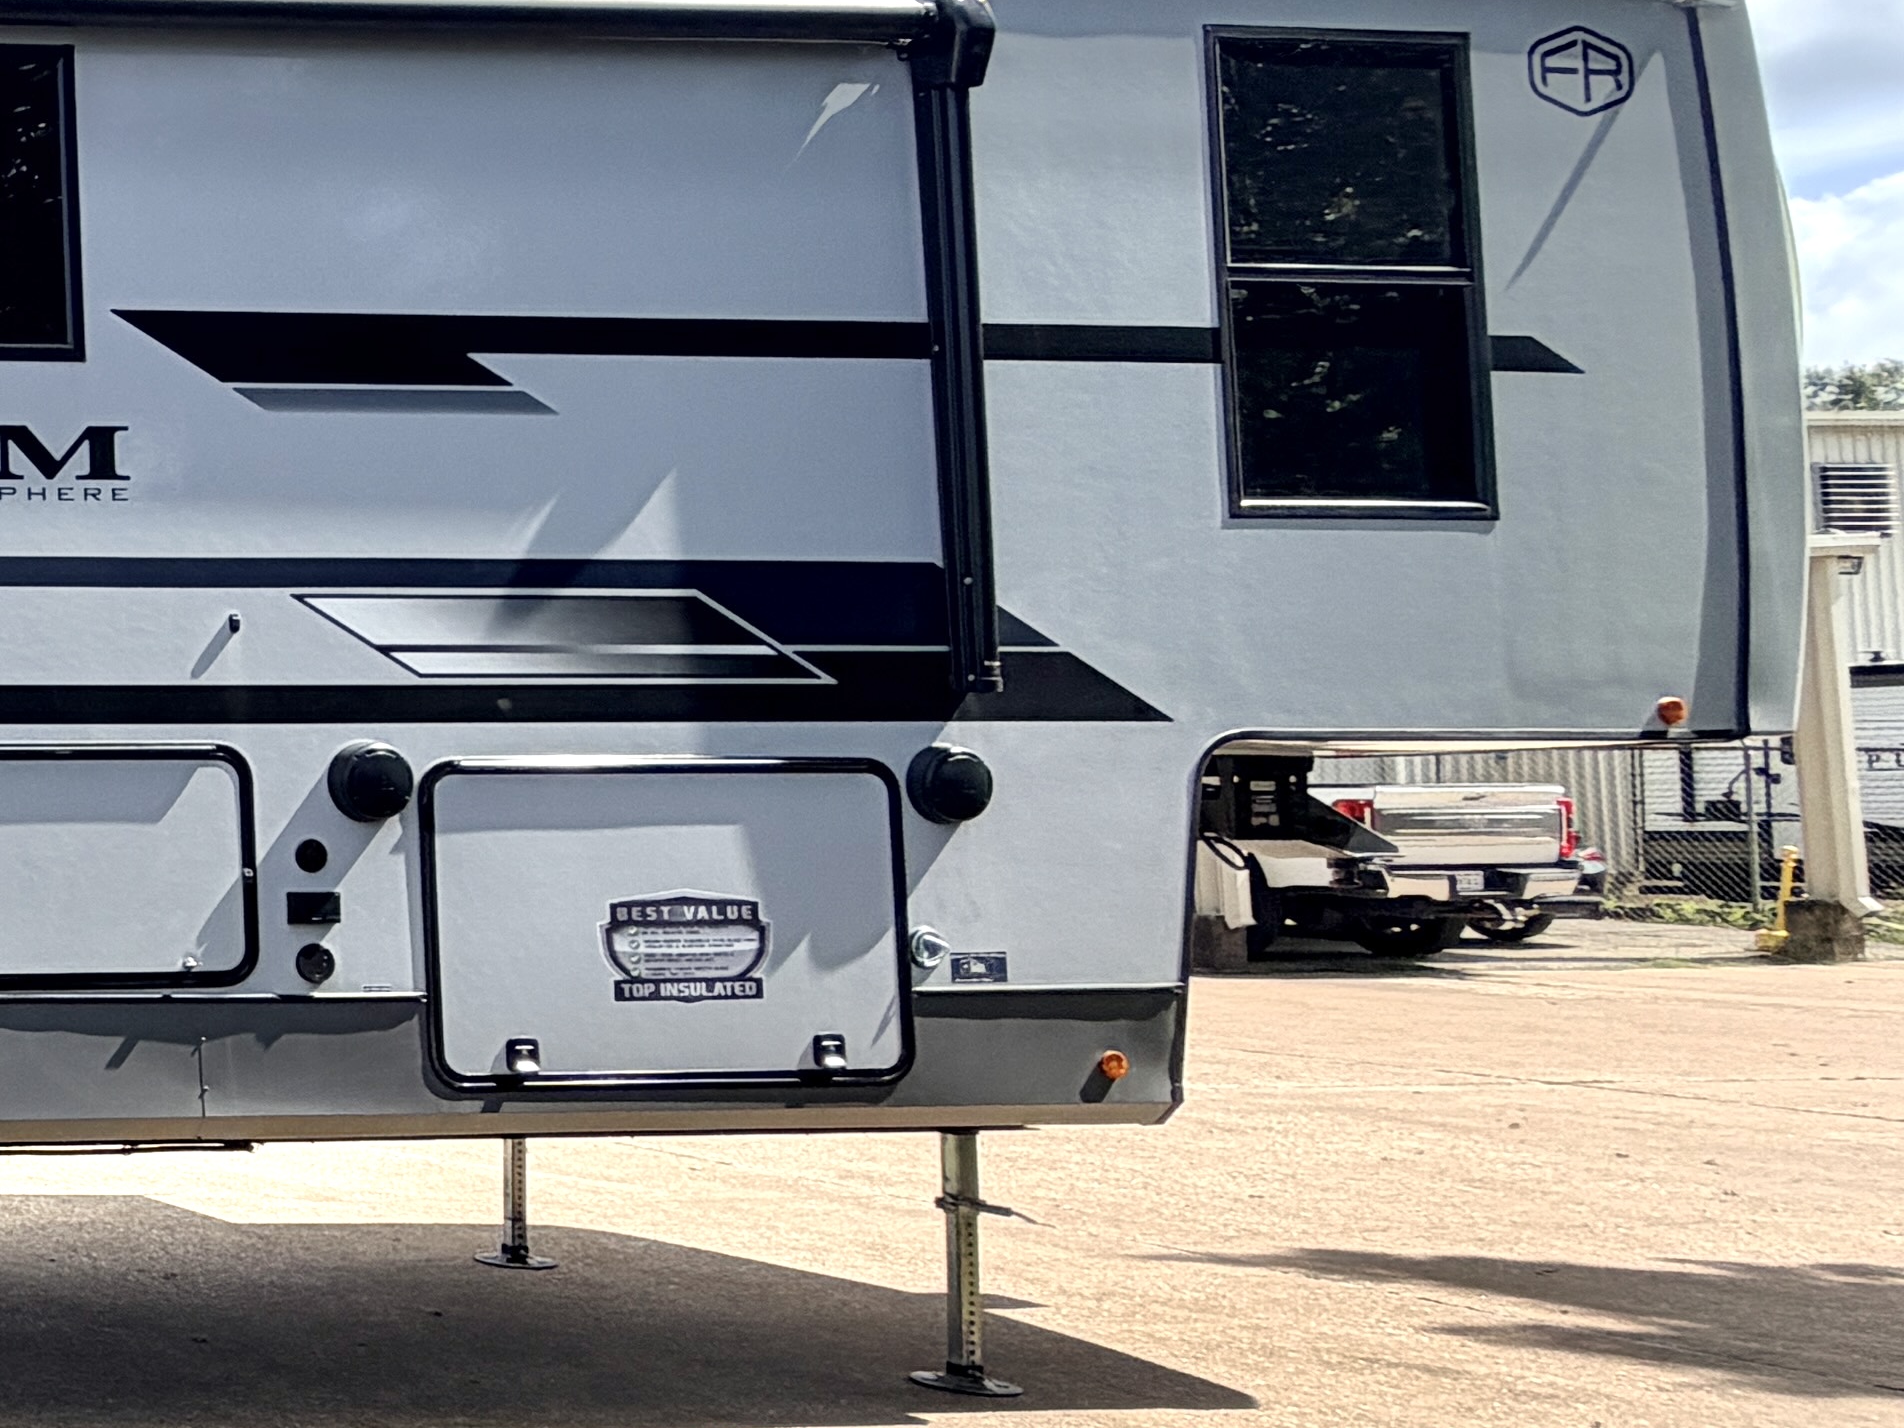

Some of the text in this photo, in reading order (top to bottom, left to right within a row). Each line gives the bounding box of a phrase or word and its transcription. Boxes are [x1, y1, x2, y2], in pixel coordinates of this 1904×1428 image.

[616, 905, 753, 921] BEST VALUE
[620, 981, 758, 998] TOP INSULATED
